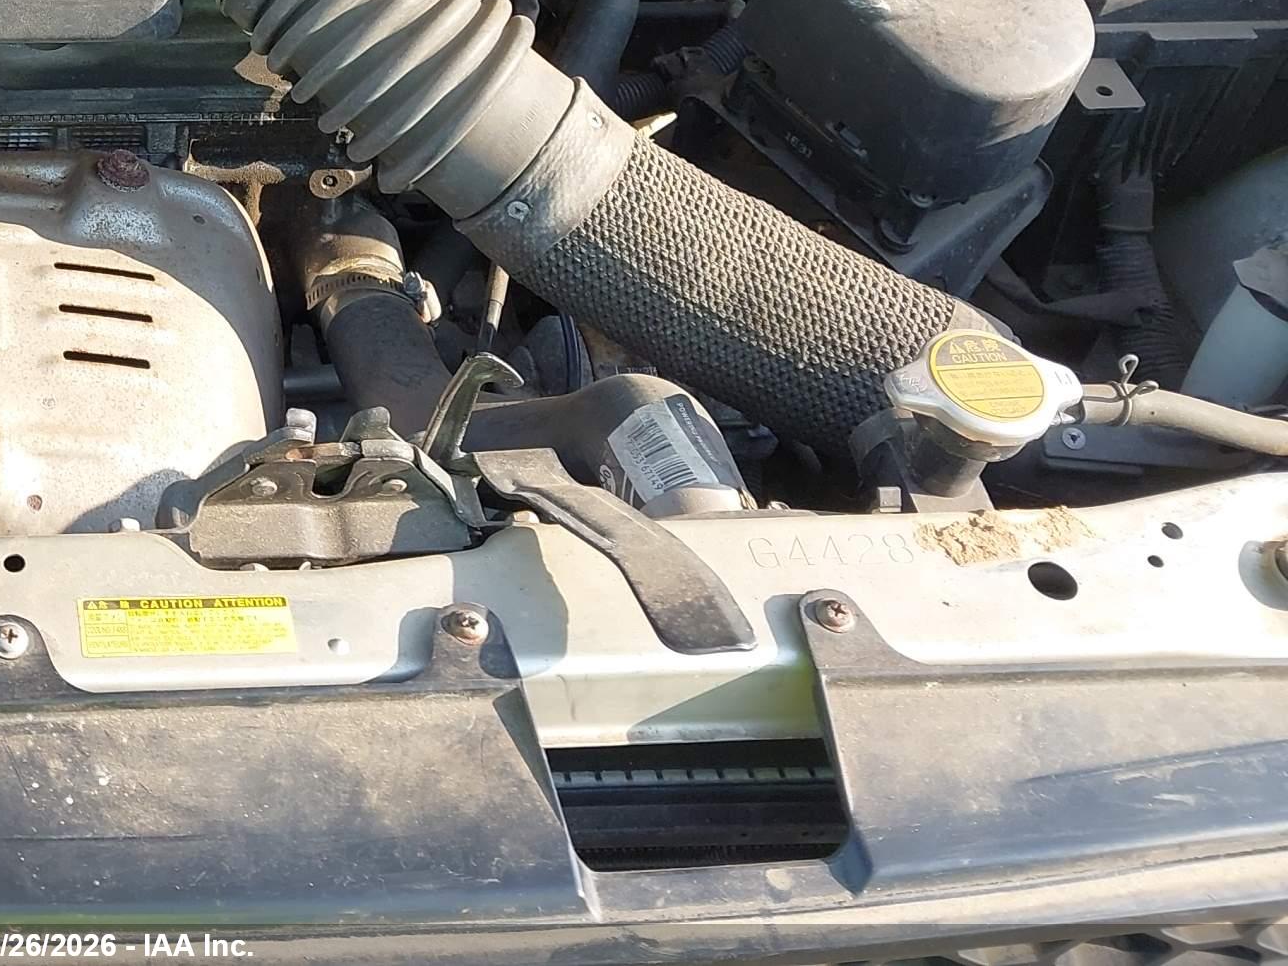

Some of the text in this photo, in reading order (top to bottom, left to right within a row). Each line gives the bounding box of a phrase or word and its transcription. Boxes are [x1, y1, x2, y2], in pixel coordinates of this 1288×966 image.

[951, 352, 1008, 364] CAUTION
[139, 597, 283, 610] CAUTION ATTENTION
